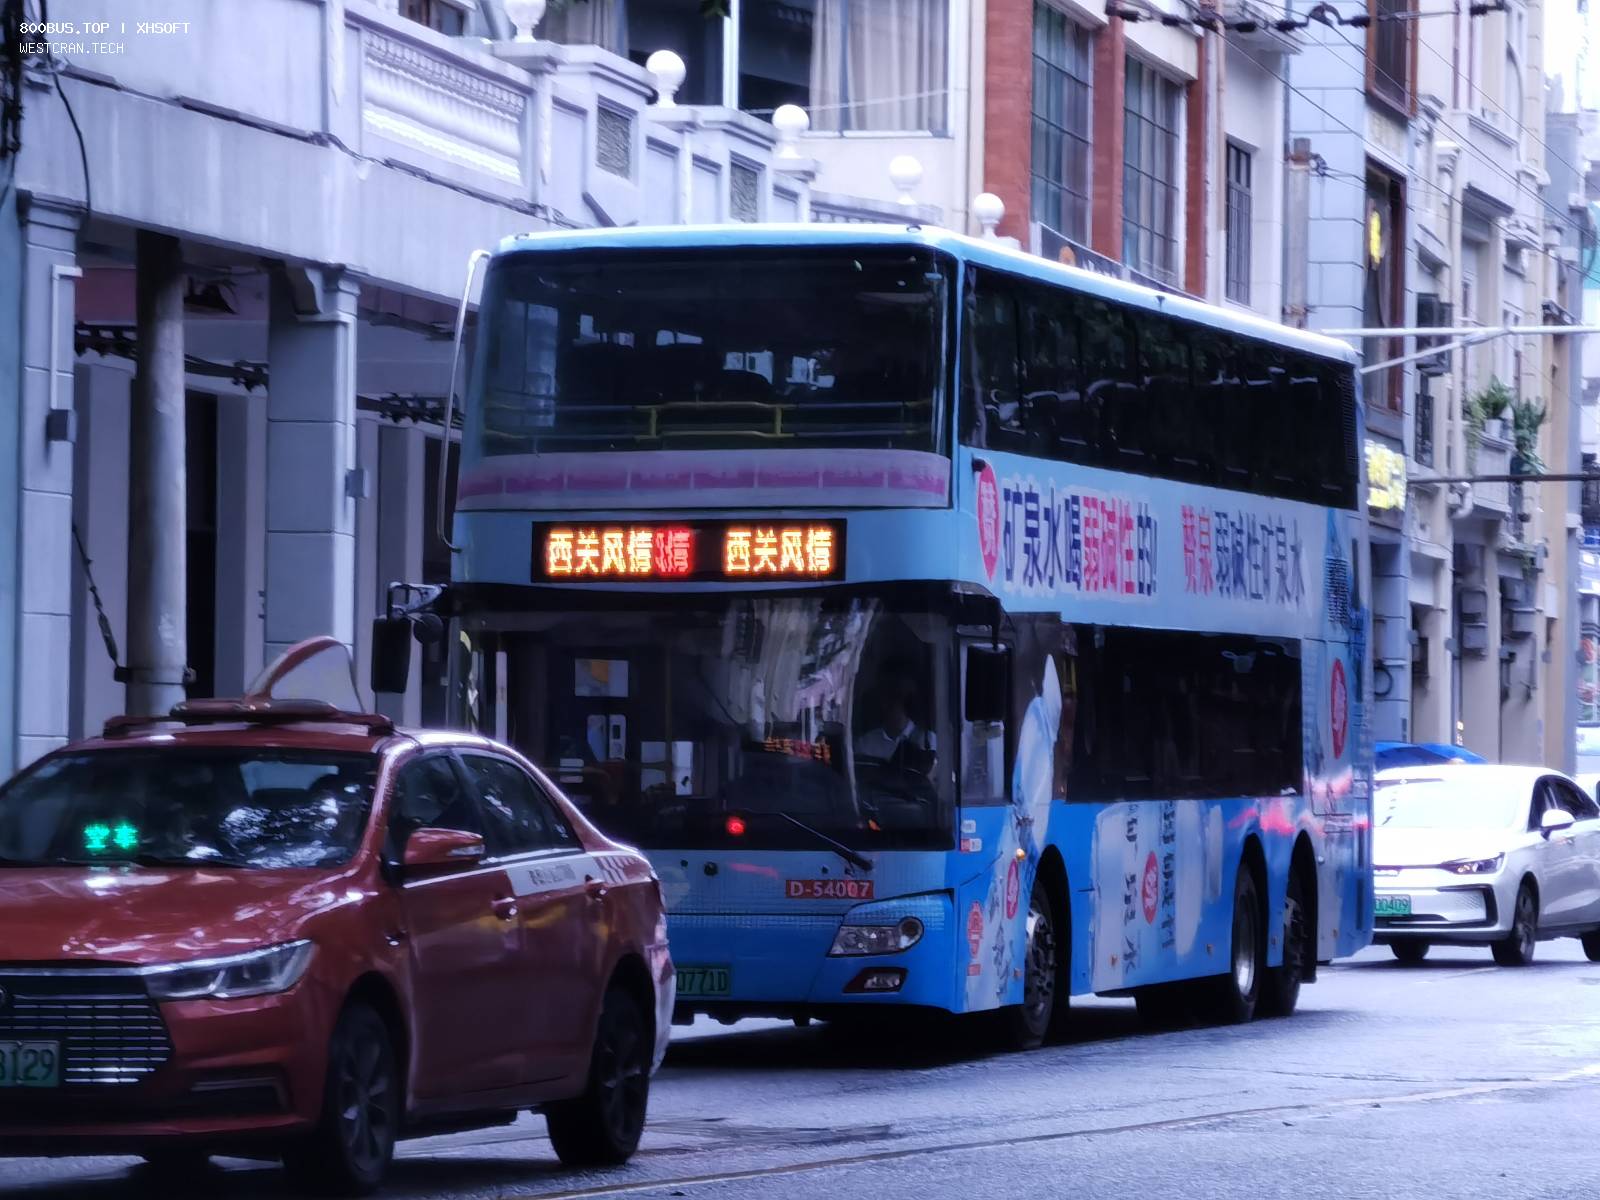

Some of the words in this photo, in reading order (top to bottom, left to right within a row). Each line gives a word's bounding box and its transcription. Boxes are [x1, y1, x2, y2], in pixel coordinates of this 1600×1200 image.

[725, 528, 832, 573] 西关风情
[790, 881, 870, 897] D-54007
